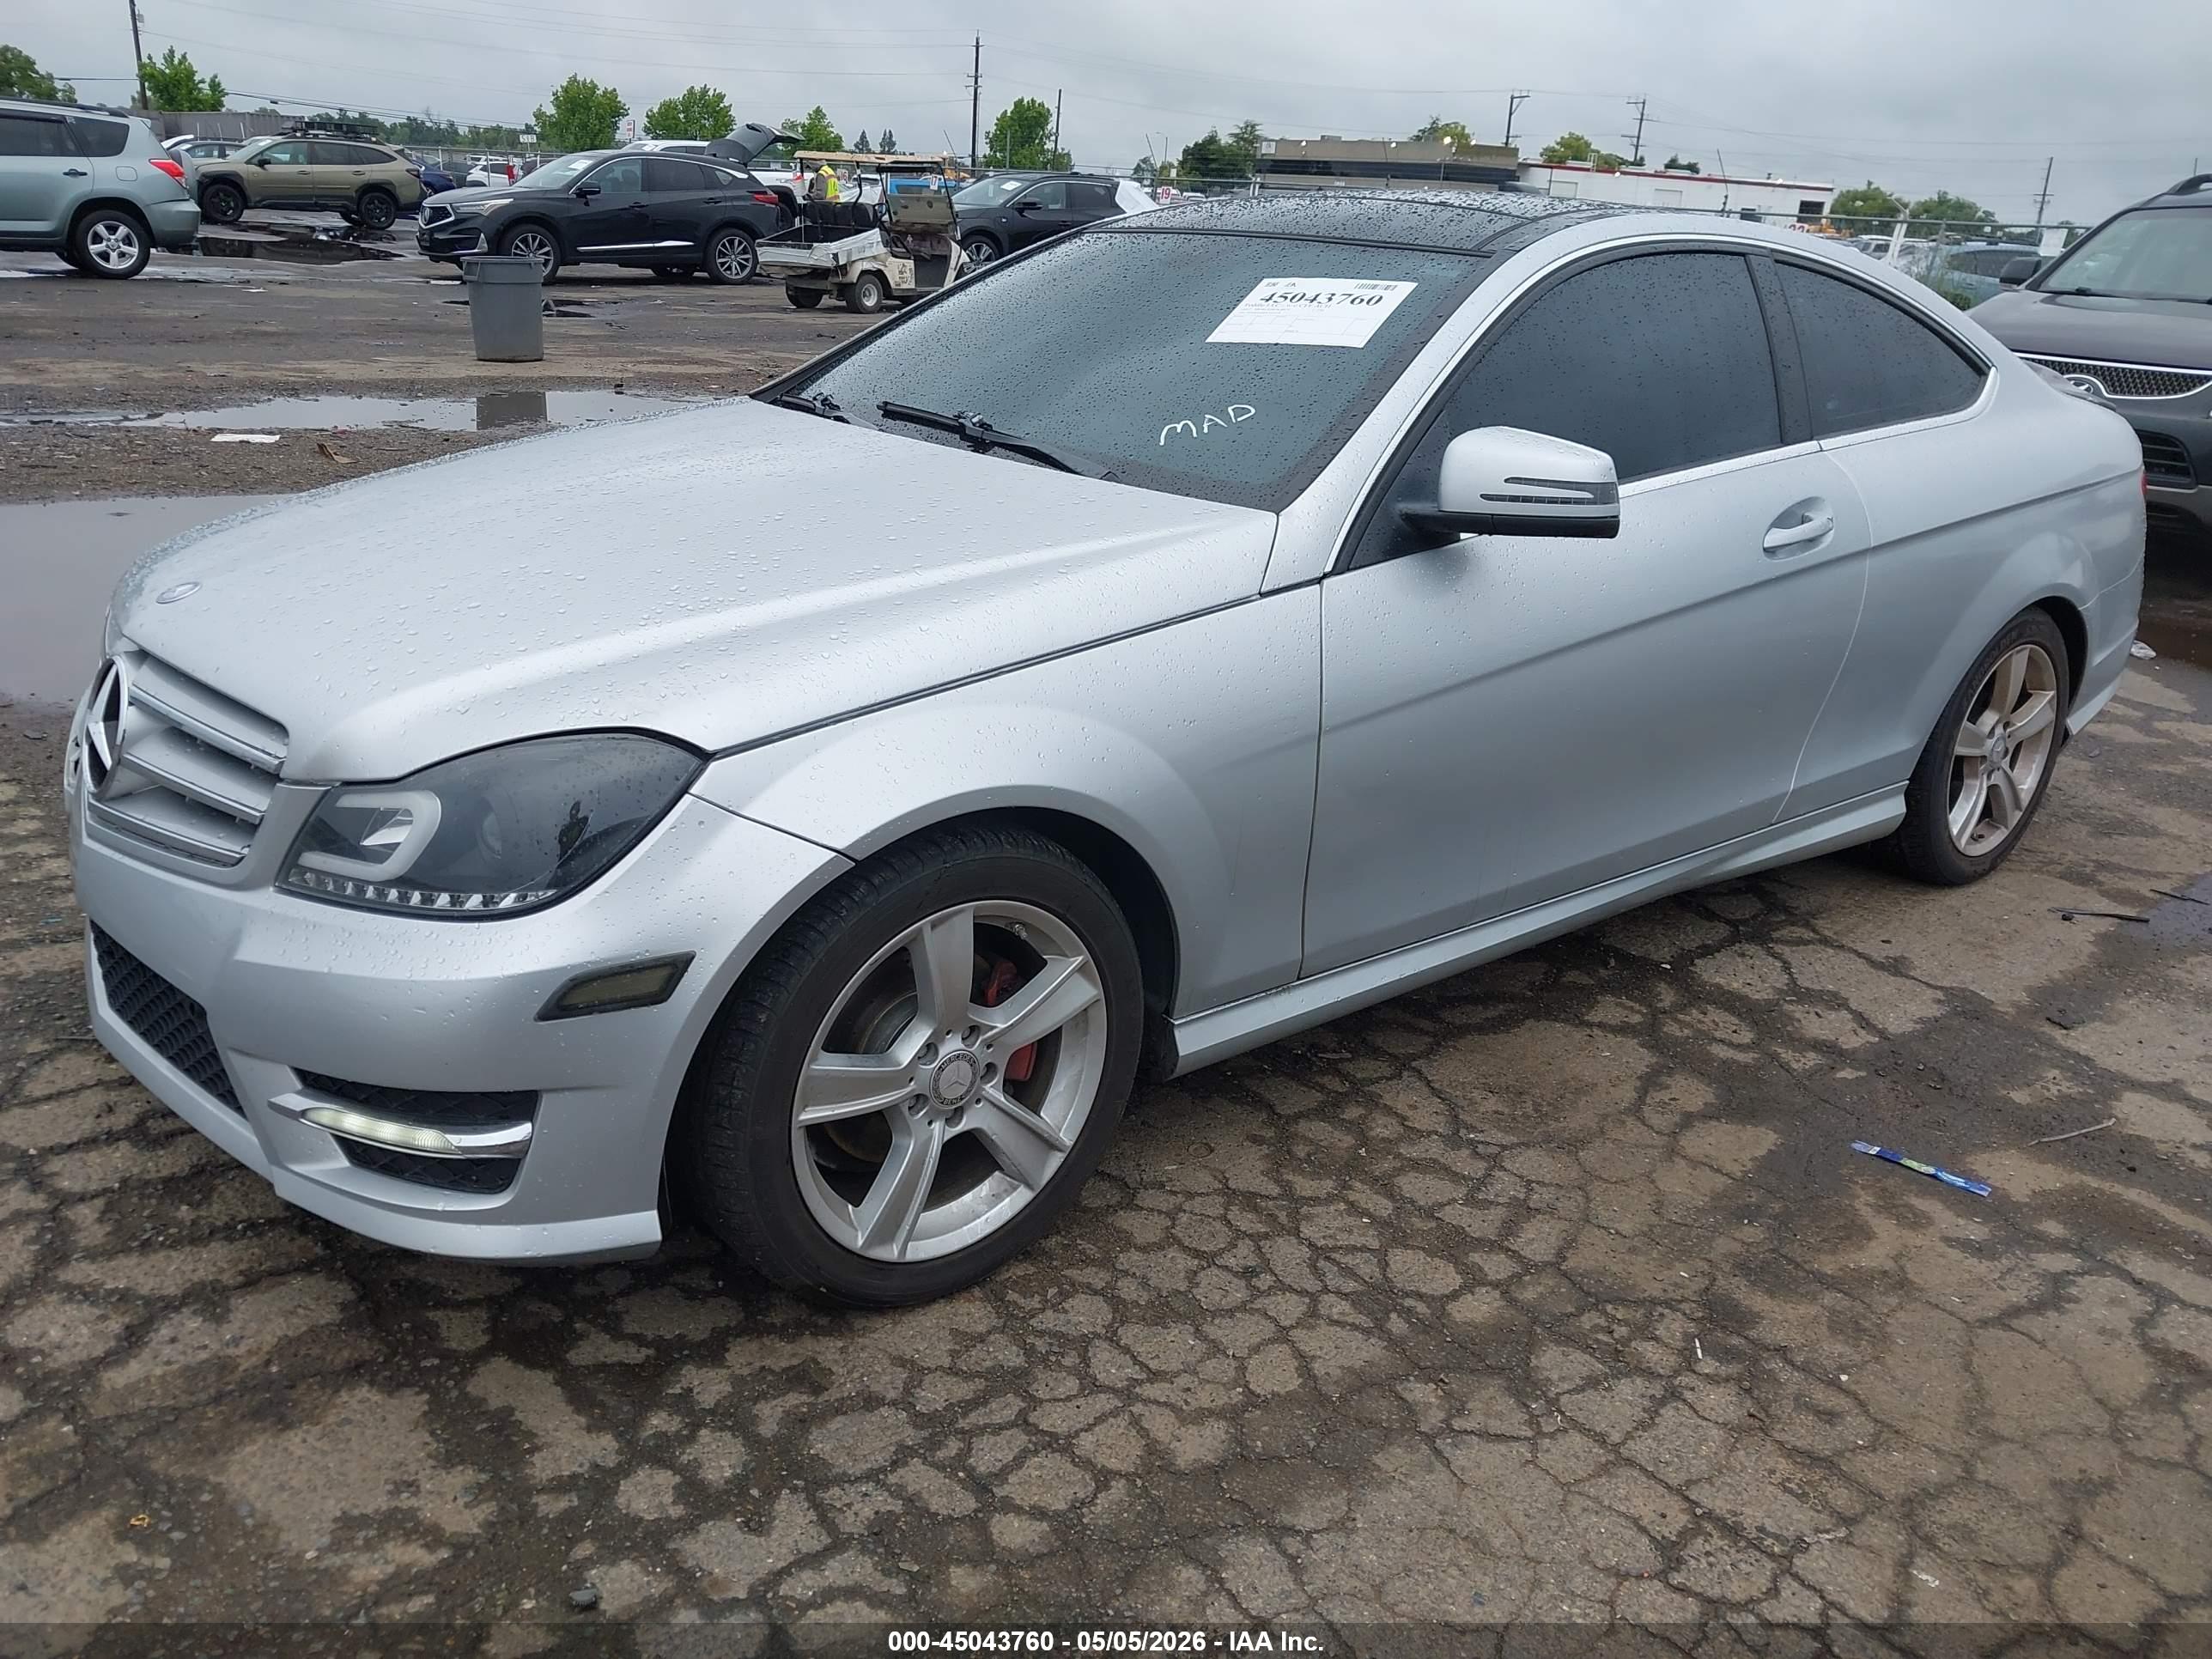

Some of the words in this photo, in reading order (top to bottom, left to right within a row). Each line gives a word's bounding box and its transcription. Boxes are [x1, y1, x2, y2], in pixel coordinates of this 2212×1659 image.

[841, 171, 848, 181] 16
[1161, 188, 1170, 199] 19
[1260, 291, 1383, 307] 45043760
[1159, 404, 1256, 447] MAD
[941, 1053, 975, 1070] MERCEDES
